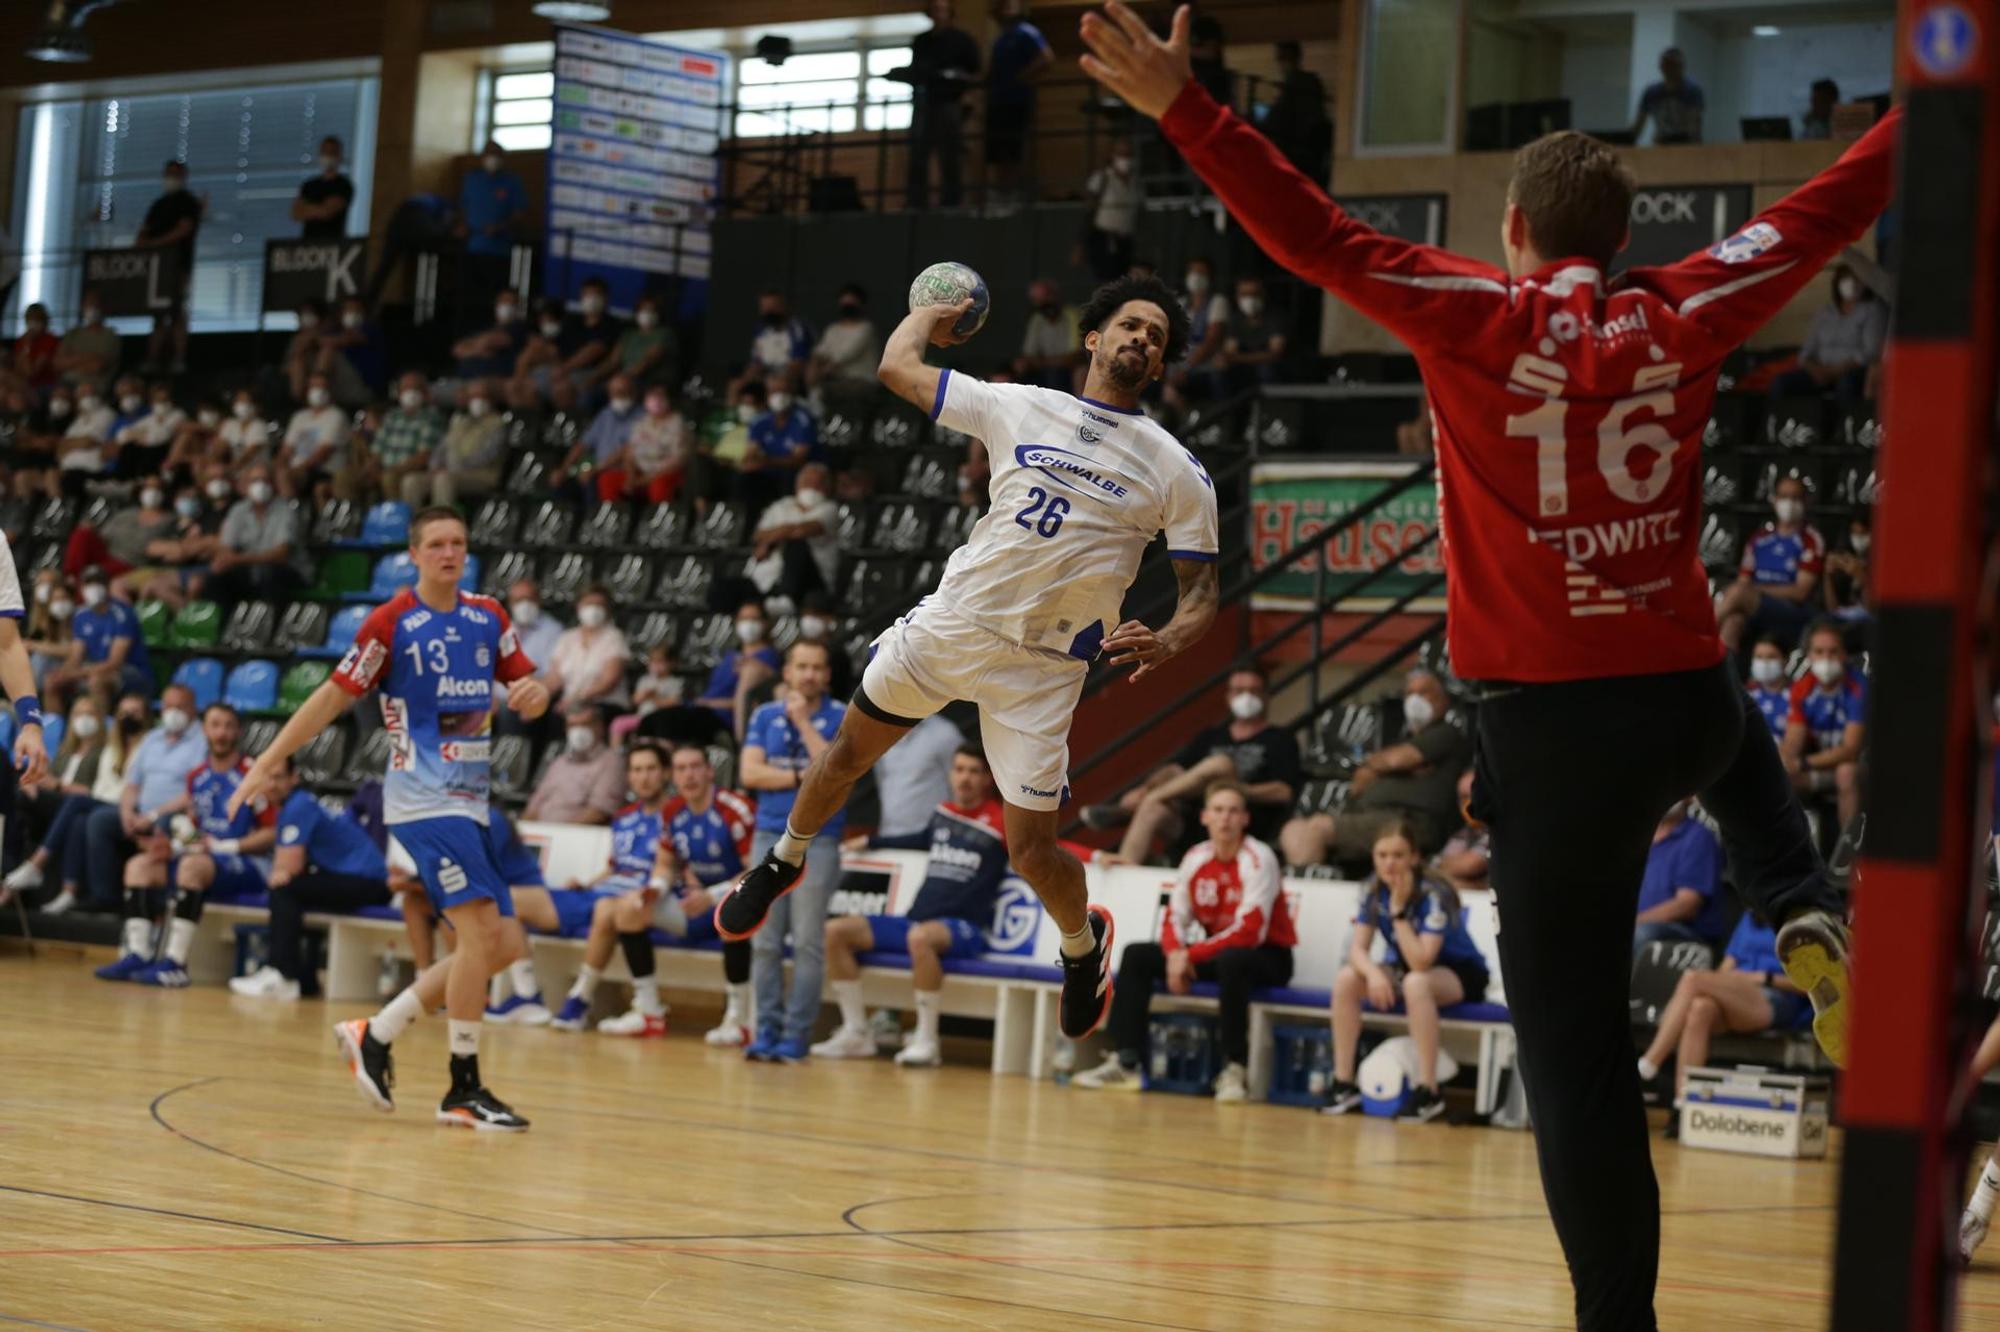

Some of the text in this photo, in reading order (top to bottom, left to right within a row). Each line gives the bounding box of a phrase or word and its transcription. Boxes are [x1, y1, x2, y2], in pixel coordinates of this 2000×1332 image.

[1631, 192, 1695, 223] OCK
[1505, 388, 1680, 517] 16
[1028, 453, 1128, 498] SCHWALBE
[1015, 486, 1071, 538] 26
[405, 639, 449, 676] 13
[437, 675, 489, 697] Alcon
[1690, 1109, 1785, 1138] Dolobene
